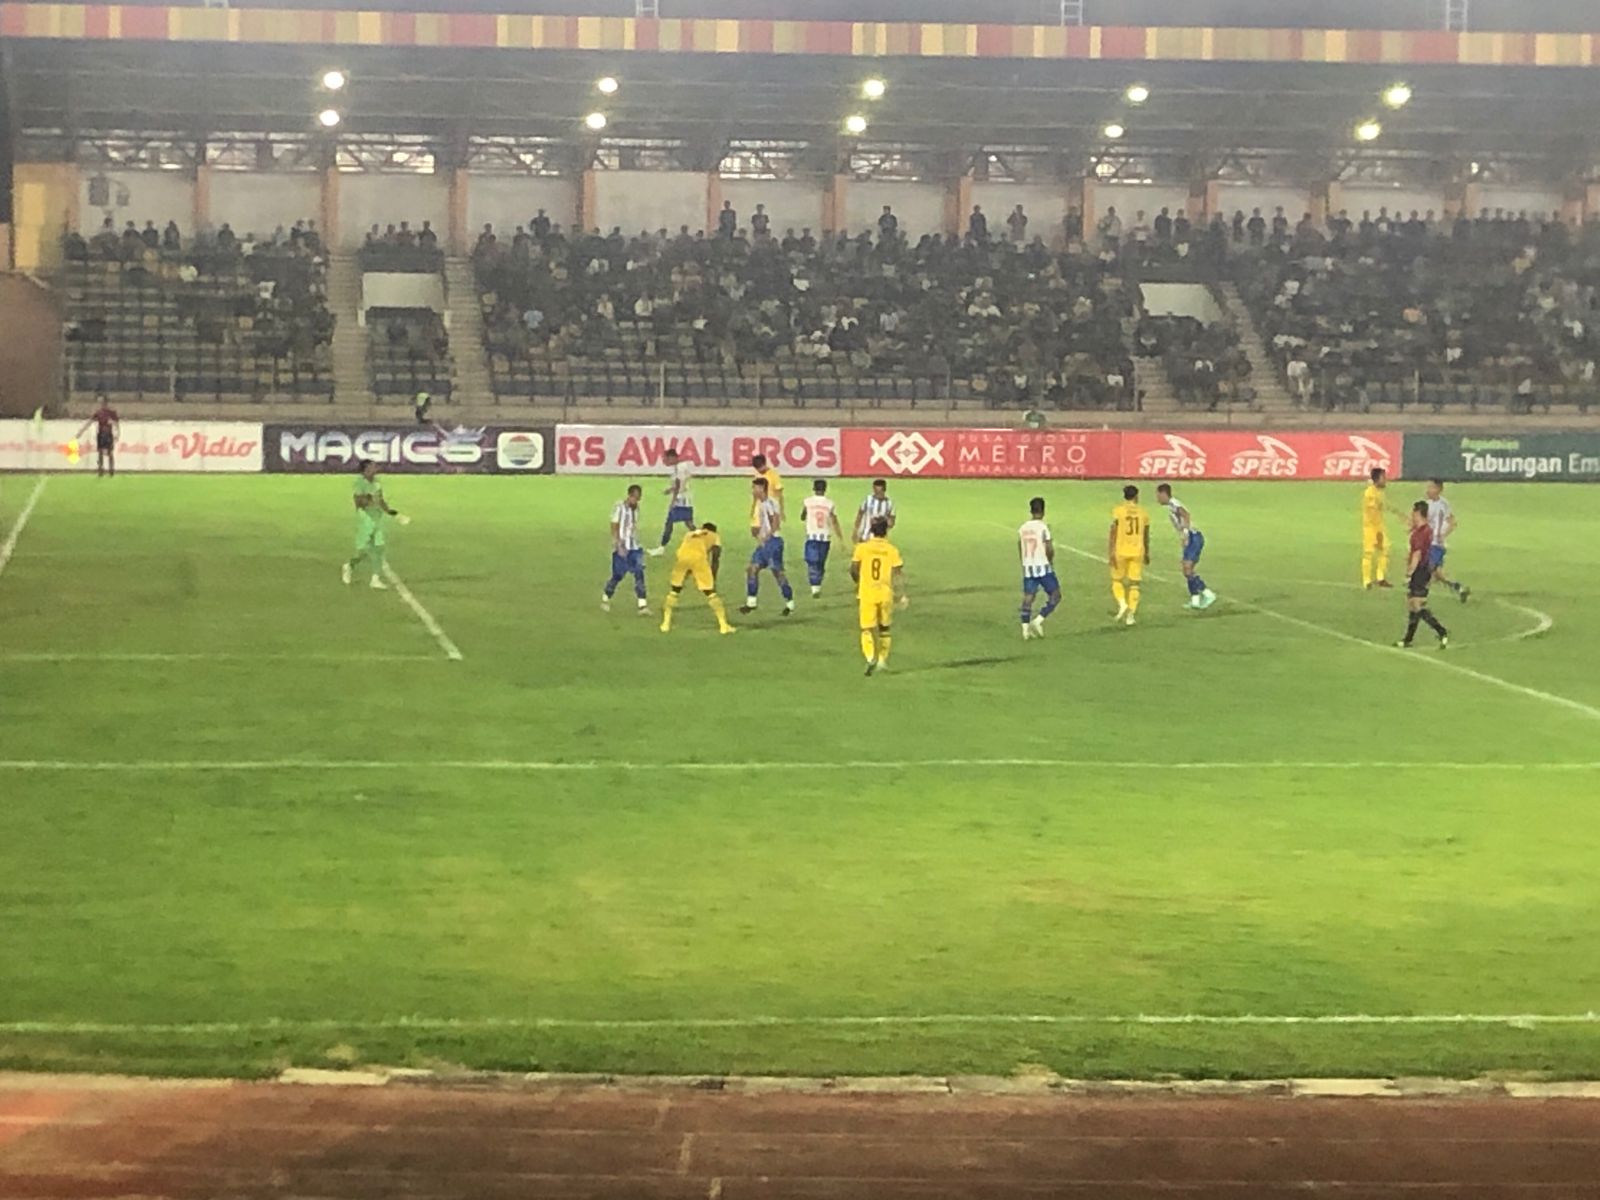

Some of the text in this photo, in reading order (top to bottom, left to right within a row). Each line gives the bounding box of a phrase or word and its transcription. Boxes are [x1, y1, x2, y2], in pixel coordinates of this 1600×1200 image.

[172, 433, 257, 459] Vidio
[558, 436, 836, 468] RS AWAL BROS
[959, 445, 1087, 464] METRO
[1139, 457, 1207, 476] SPECS
[1231, 458, 1298, 477] SPECS
[1323, 458, 1391, 477] SPECS
[1461, 452, 1562, 478] Tabungan
[1125, 516, 1139, 536] 31
[871, 558, 882, 581] 8
